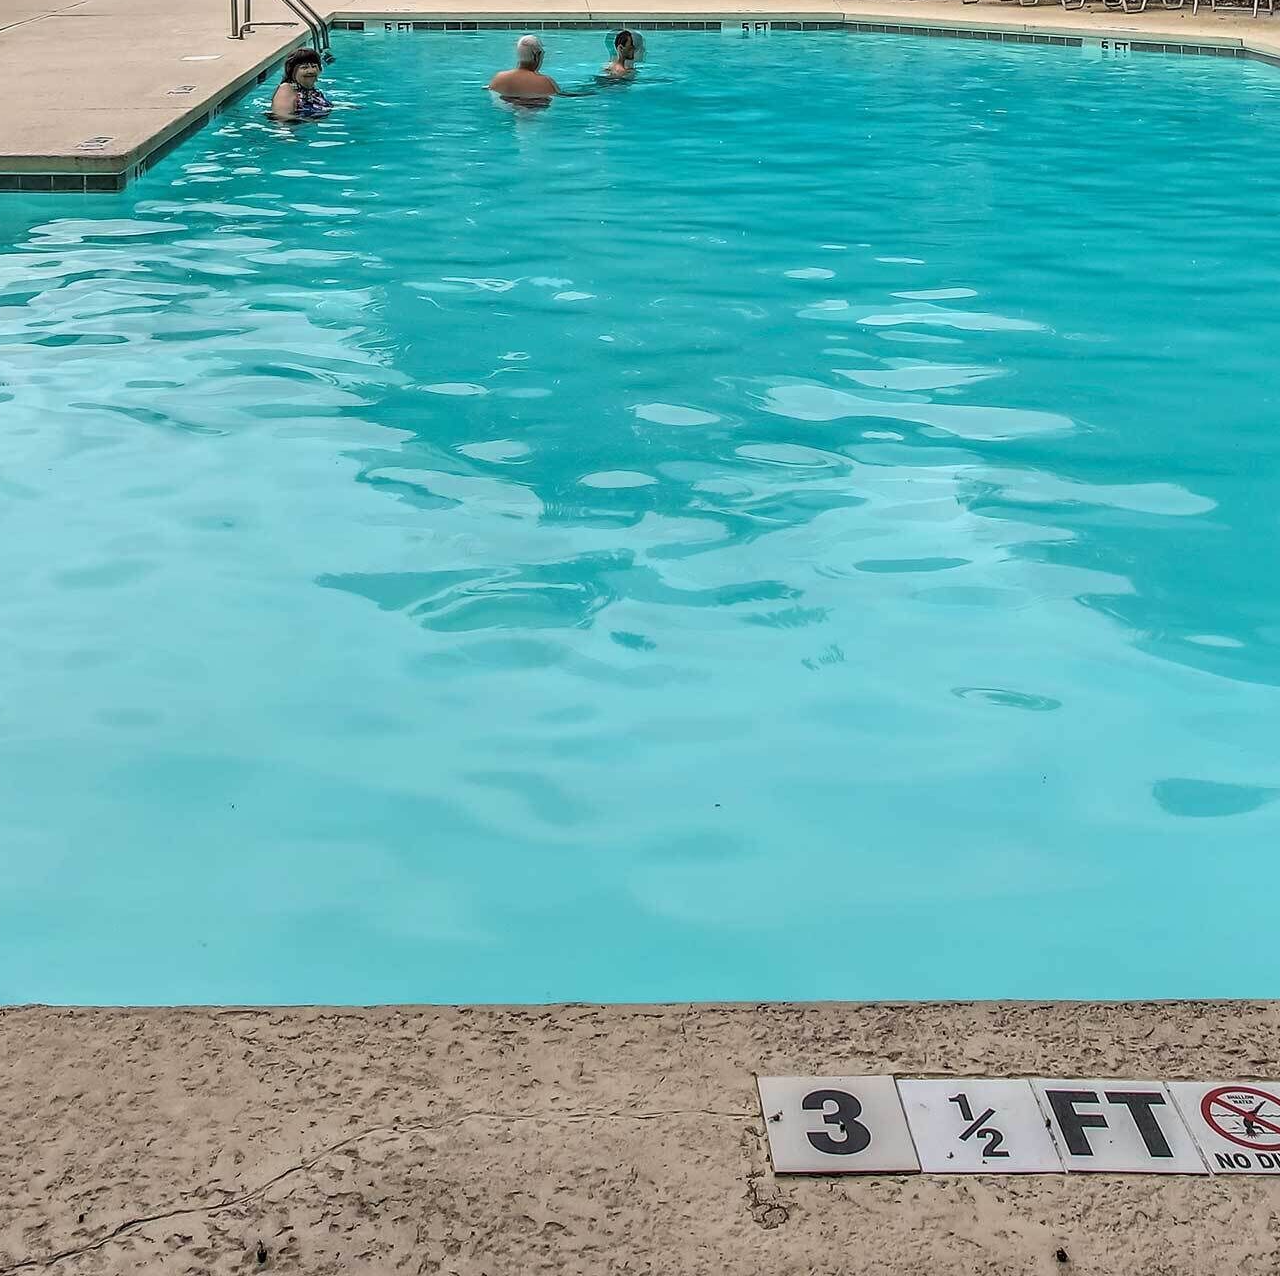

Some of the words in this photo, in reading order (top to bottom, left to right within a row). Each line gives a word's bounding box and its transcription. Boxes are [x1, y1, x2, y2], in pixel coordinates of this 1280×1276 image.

[801, 1089, 871, 1155] 3
[1045, 1090, 1173, 1158] FT
[1213, 1153, 1251, 1168] NO
